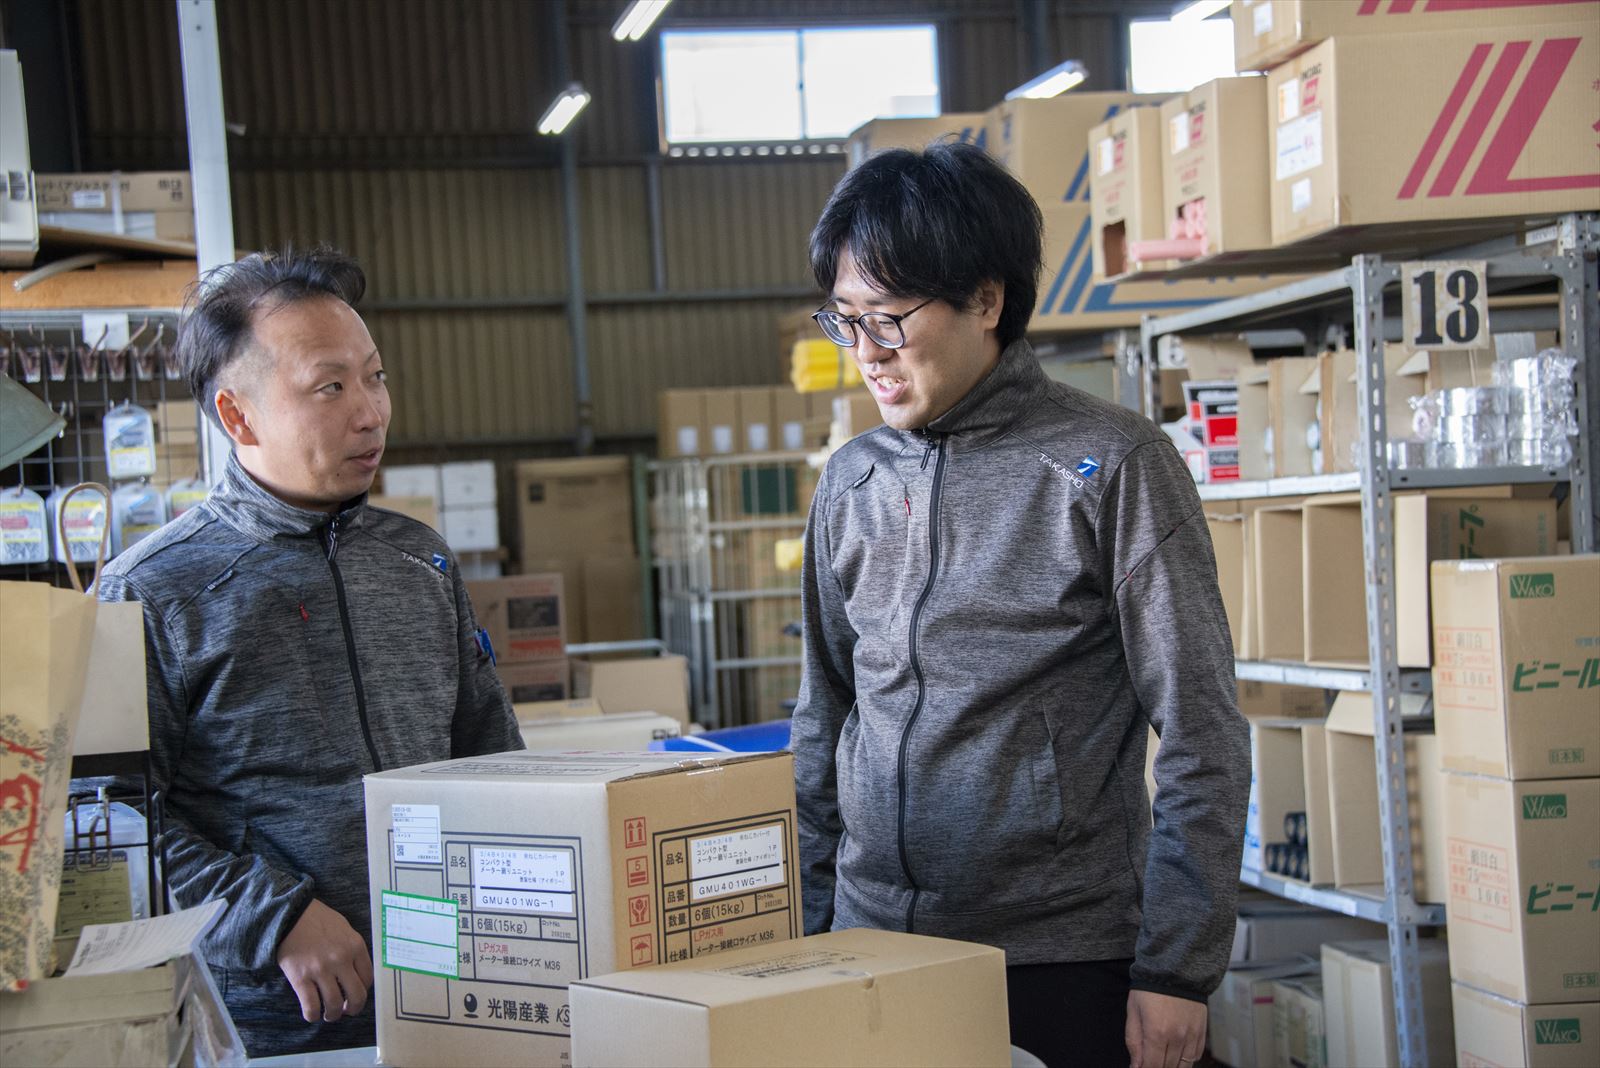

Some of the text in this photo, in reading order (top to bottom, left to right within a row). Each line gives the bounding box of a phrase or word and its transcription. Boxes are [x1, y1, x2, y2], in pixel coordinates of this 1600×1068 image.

[1413, 269, 1479, 346] 13
[1040, 453, 1084, 489] TAKASHO
[1511, 576, 1555, 598] WAKO
[1524, 796, 1567, 819] WAKO
[450, 855, 467, 869] 品名
[665, 851, 684, 866] 品名
[698, 874, 769, 896] GMU401WG-1
[481, 895, 555, 909] GMU401WG-1
[666, 889, 686, 904] 品番
[694, 899, 746, 922] 6個(15kg)
[477, 918, 528, 935] 6個(15kg)
[667, 912, 687, 928] 数量
[693, 926, 724, 943] LPガス用
[696, 929, 775, 956] メーター接続口サイズ M36
[478, 942, 509, 955] LPガス用
[669, 948, 689, 963] 仕様
[479, 954, 561, 972] メーター接続口サイズ M36
[487, 997, 550, 1024] 光陽産業
[1536, 1020, 1581, 1044] WAKO
